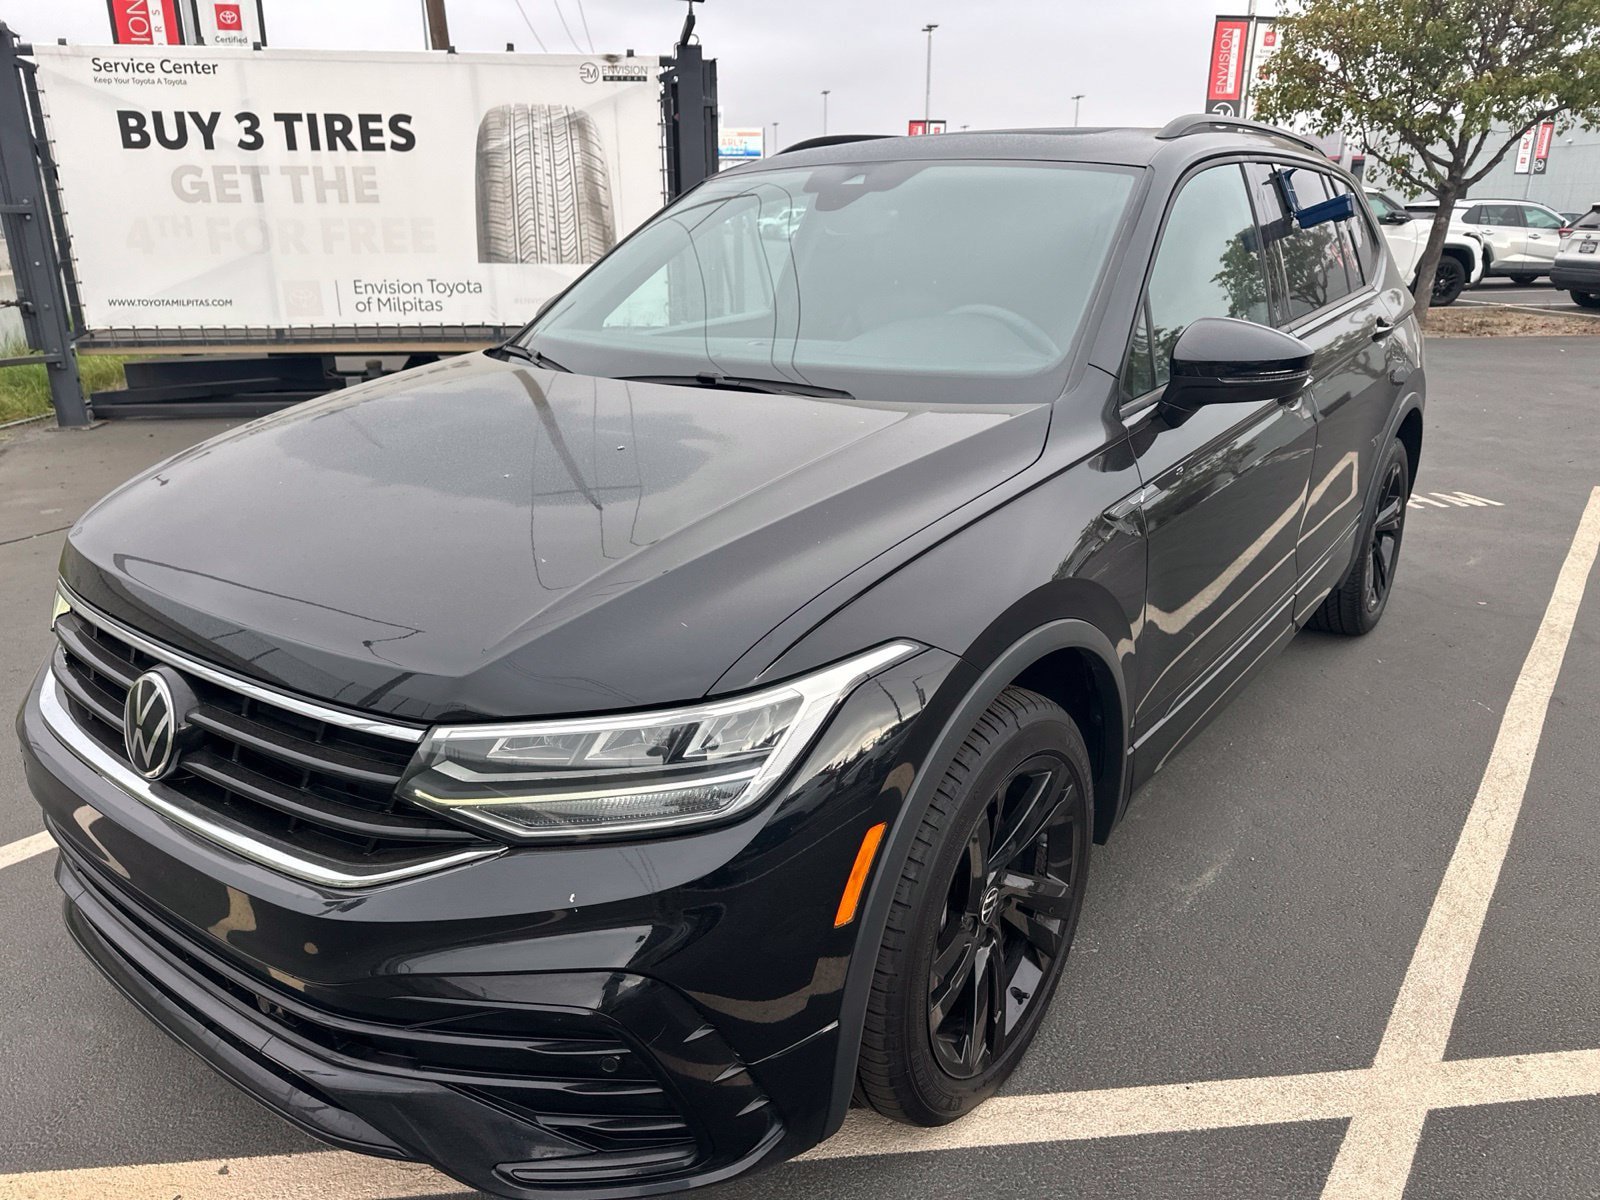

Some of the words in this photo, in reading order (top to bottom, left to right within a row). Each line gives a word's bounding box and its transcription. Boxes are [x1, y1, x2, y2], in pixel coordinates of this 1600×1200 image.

[215, 35, 248, 45] Certified
[92, 57, 155, 74] Service
[160, 59, 218, 75] Center
[602, 65, 648, 75] ENVISION
[1215, 28, 1233, 95] ENVISION
[93, 76, 113, 85] Keep
[114, 77, 130, 85] Your
[132, 77, 155, 87] Toyota
[163, 78, 187, 87] Toyota
[117, 110, 221, 150] BUY
[235, 111, 264, 151] 3
[274, 112, 416, 152] TIRES
[171, 164, 269, 204] GET
[280, 165, 380, 204] THE
[206, 215, 311, 255] FOR
[320, 215, 438, 255] FREE
[353, 279, 423, 295] Envision
[427, 278, 483, 298] Toyota
[108, 298, 233, 308] WWW.TOYOTAMILPITAS.COM
[355, 297, 373, 313] of
[377, 296, 443, 316] Milpitas
